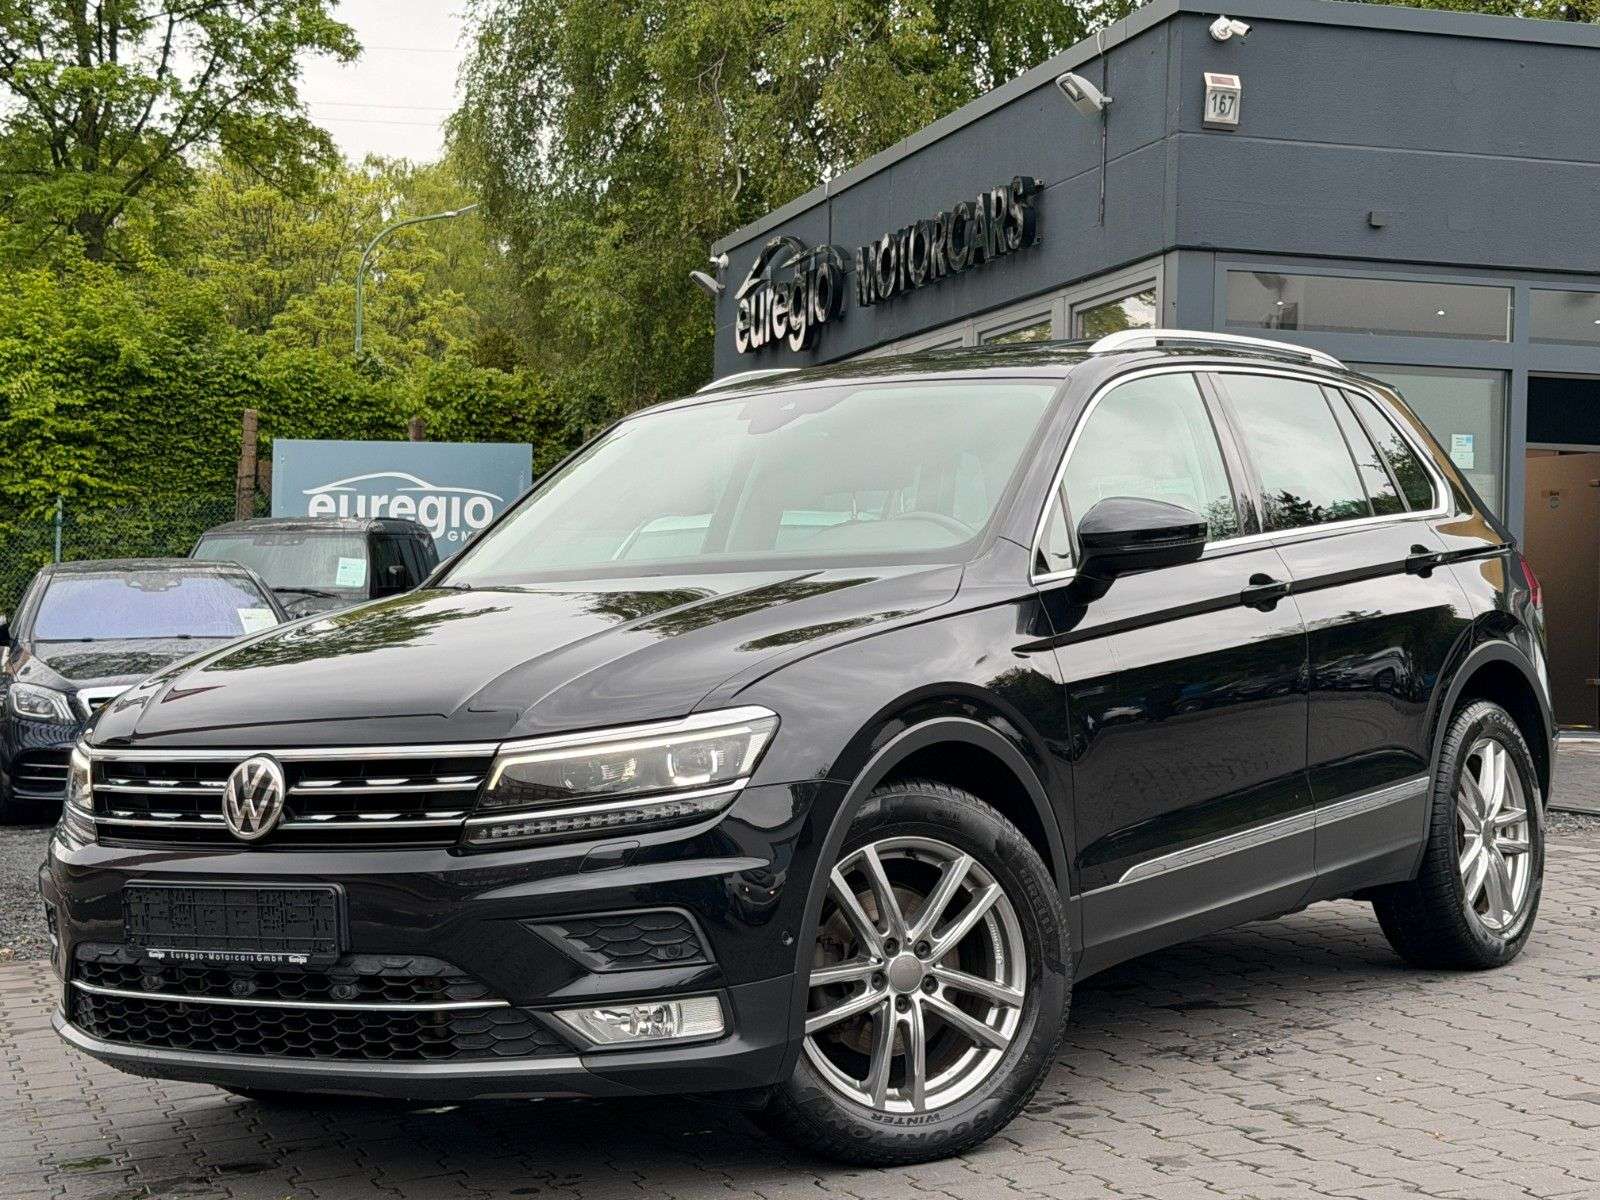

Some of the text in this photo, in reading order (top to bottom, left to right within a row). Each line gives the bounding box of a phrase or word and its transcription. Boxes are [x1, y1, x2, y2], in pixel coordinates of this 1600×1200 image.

[1212, 93, 1235, 114] 167
[735, 176, 1034, 354] euregio MOTORCARS
[308, 494, 494, 539] euregio
[871, 1112, 941, 1125] WINTER
